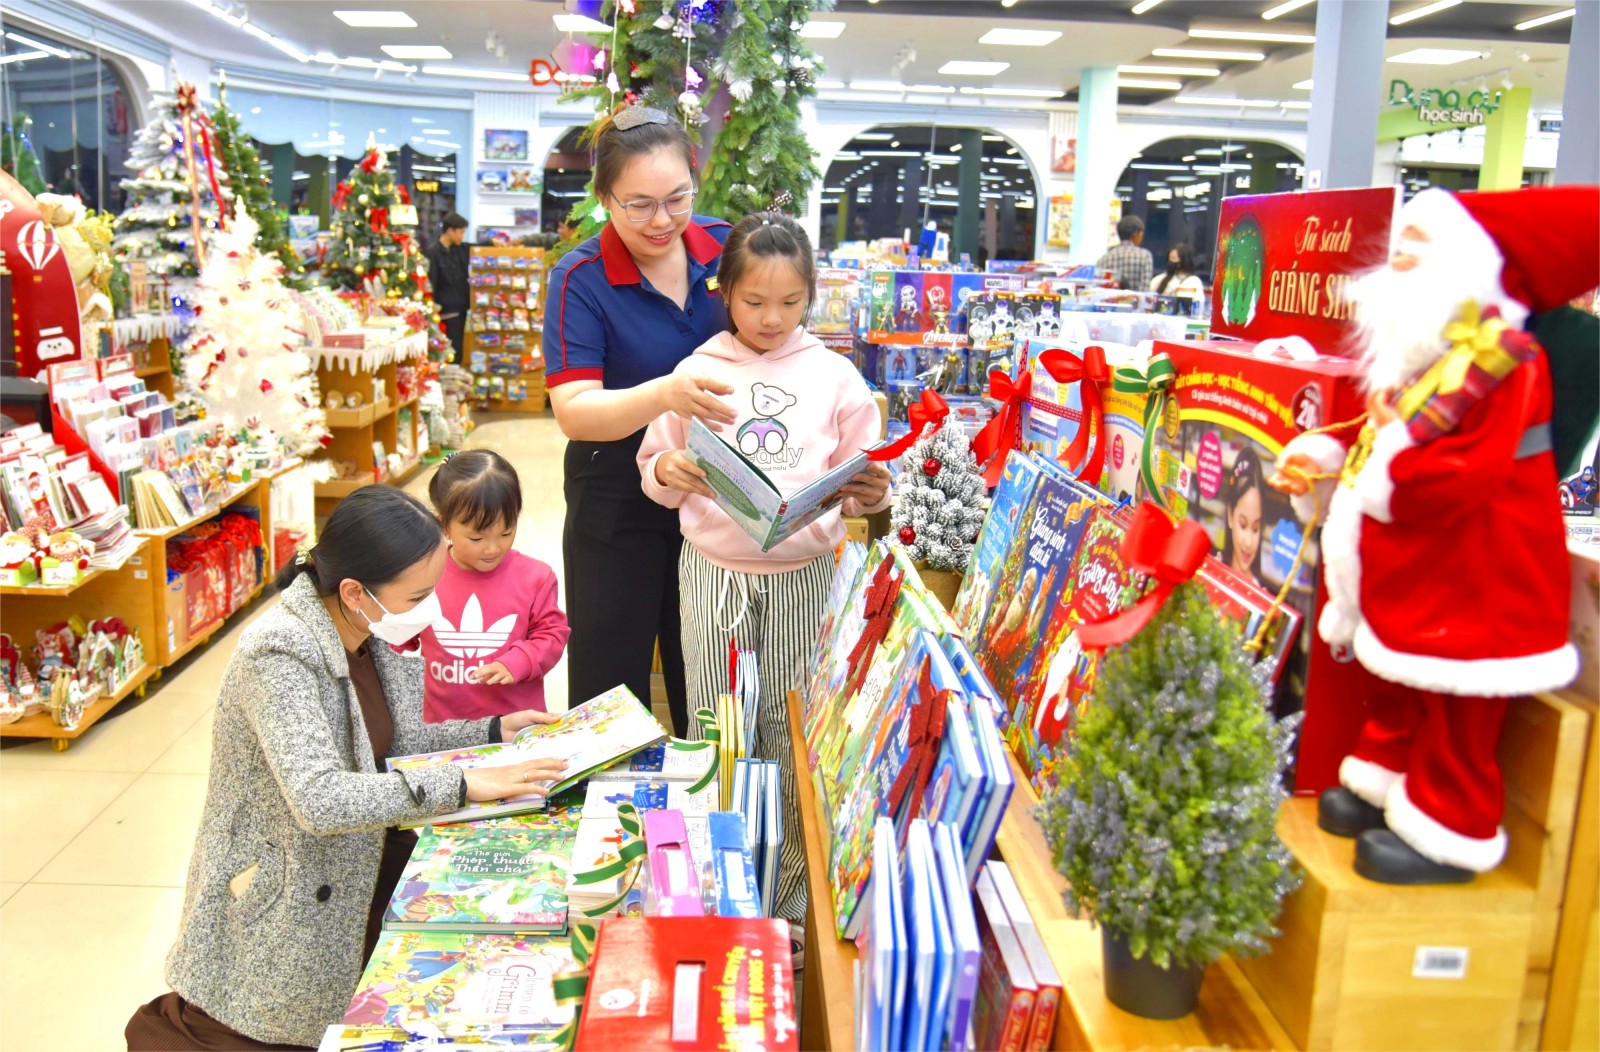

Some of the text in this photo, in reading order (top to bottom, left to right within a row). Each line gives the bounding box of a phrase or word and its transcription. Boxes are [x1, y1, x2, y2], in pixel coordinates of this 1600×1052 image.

[1419, 107, 1485, 126] học sinh
[1318, 216, 1353, 253] sách
[985, 279, 1003, 288] MARVEL
[1268, 260, 1362, 321] GIÁNG SIN
[1218, 374, 1231, 391] HỌC
[1230, 371, 1250, 396] TIẾNG
[1249, 384, 1266, 405] ANH
[1030, 501, 1054, 546] Giáng
[1049, 529, 1067, 553] sinh
[430, 659, 485, 685] adid
[450, 855, 534, 866] Phép thuật
[455, 863, 523, 874] Thần chú
[486, 964, 538, 1014] Grimm
